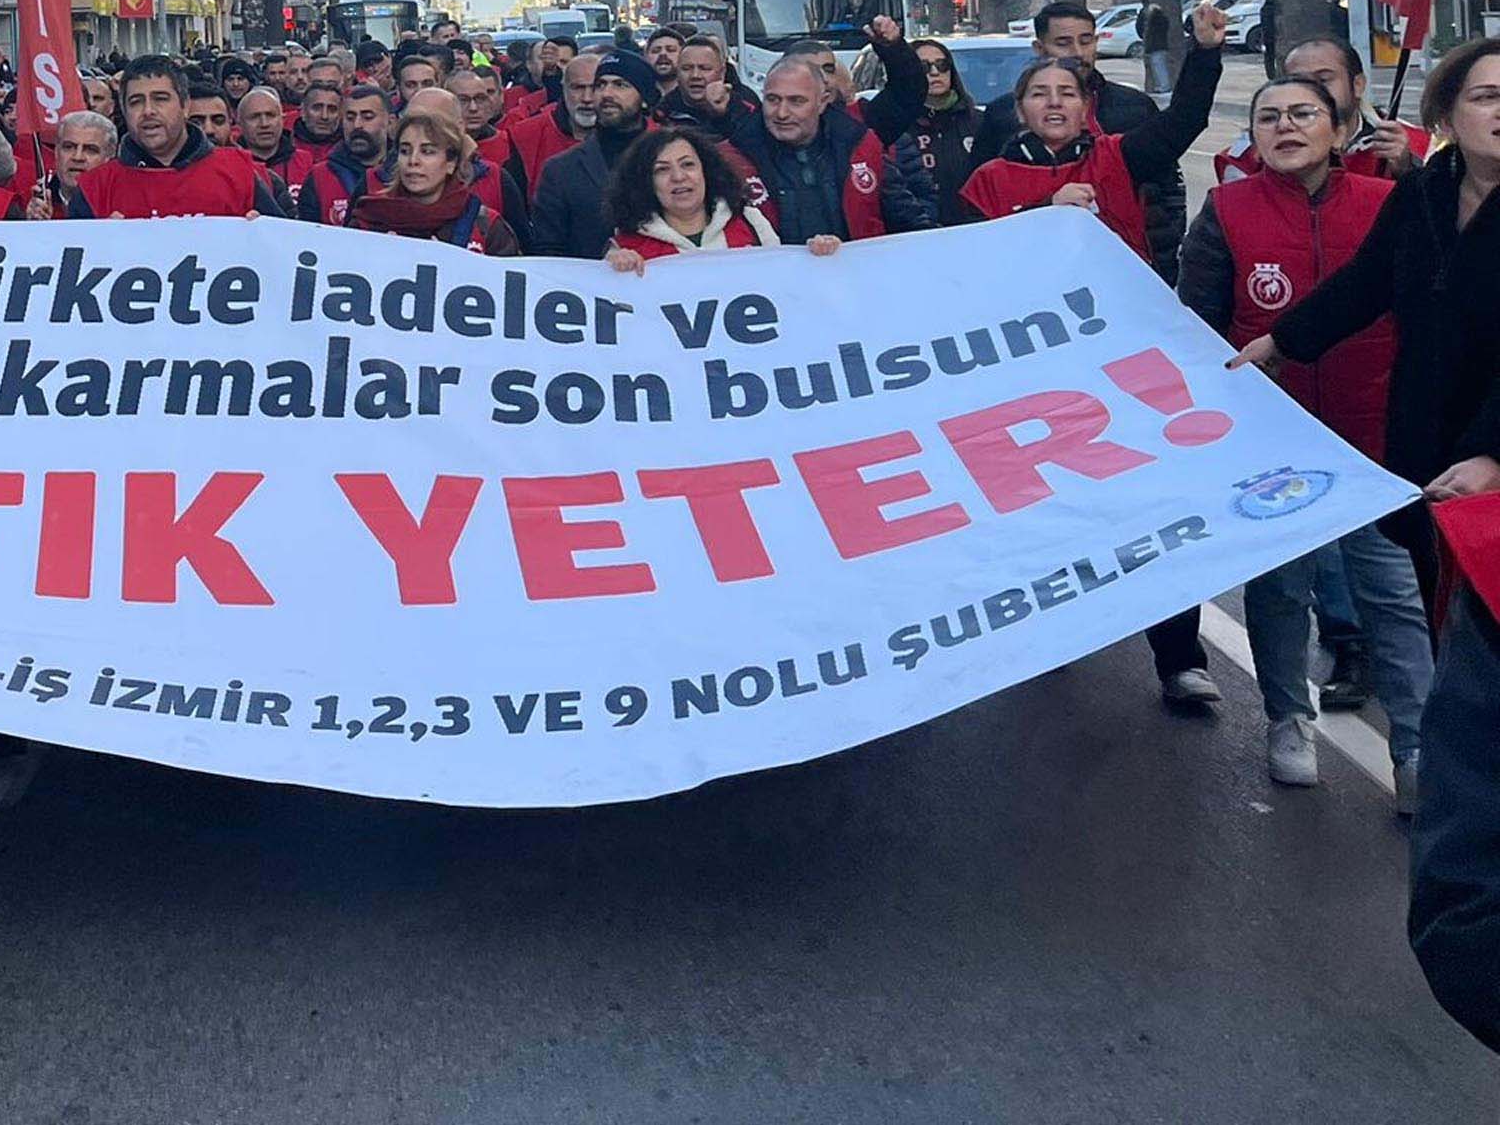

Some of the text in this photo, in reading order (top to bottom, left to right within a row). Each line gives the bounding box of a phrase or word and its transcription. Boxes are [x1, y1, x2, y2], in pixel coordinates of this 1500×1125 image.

[290, 251, 634, 345] iadeler
[661, 293, 780, 349] ve
[492, 367, 672, 424] son
[704, 287, 1107, 420] bulsun!
[334, 347, 1234, 605] YETER!
[89, 668, 291, 728] İZMİR
[311, 695, 471, 742] 1,2,3
[493, 691, 583, 735] VE
[605, 686, 648, 727] 9
[670, 641, 868, 719] NOLU
[887, 515, 1213, 671] ŞUBELER
